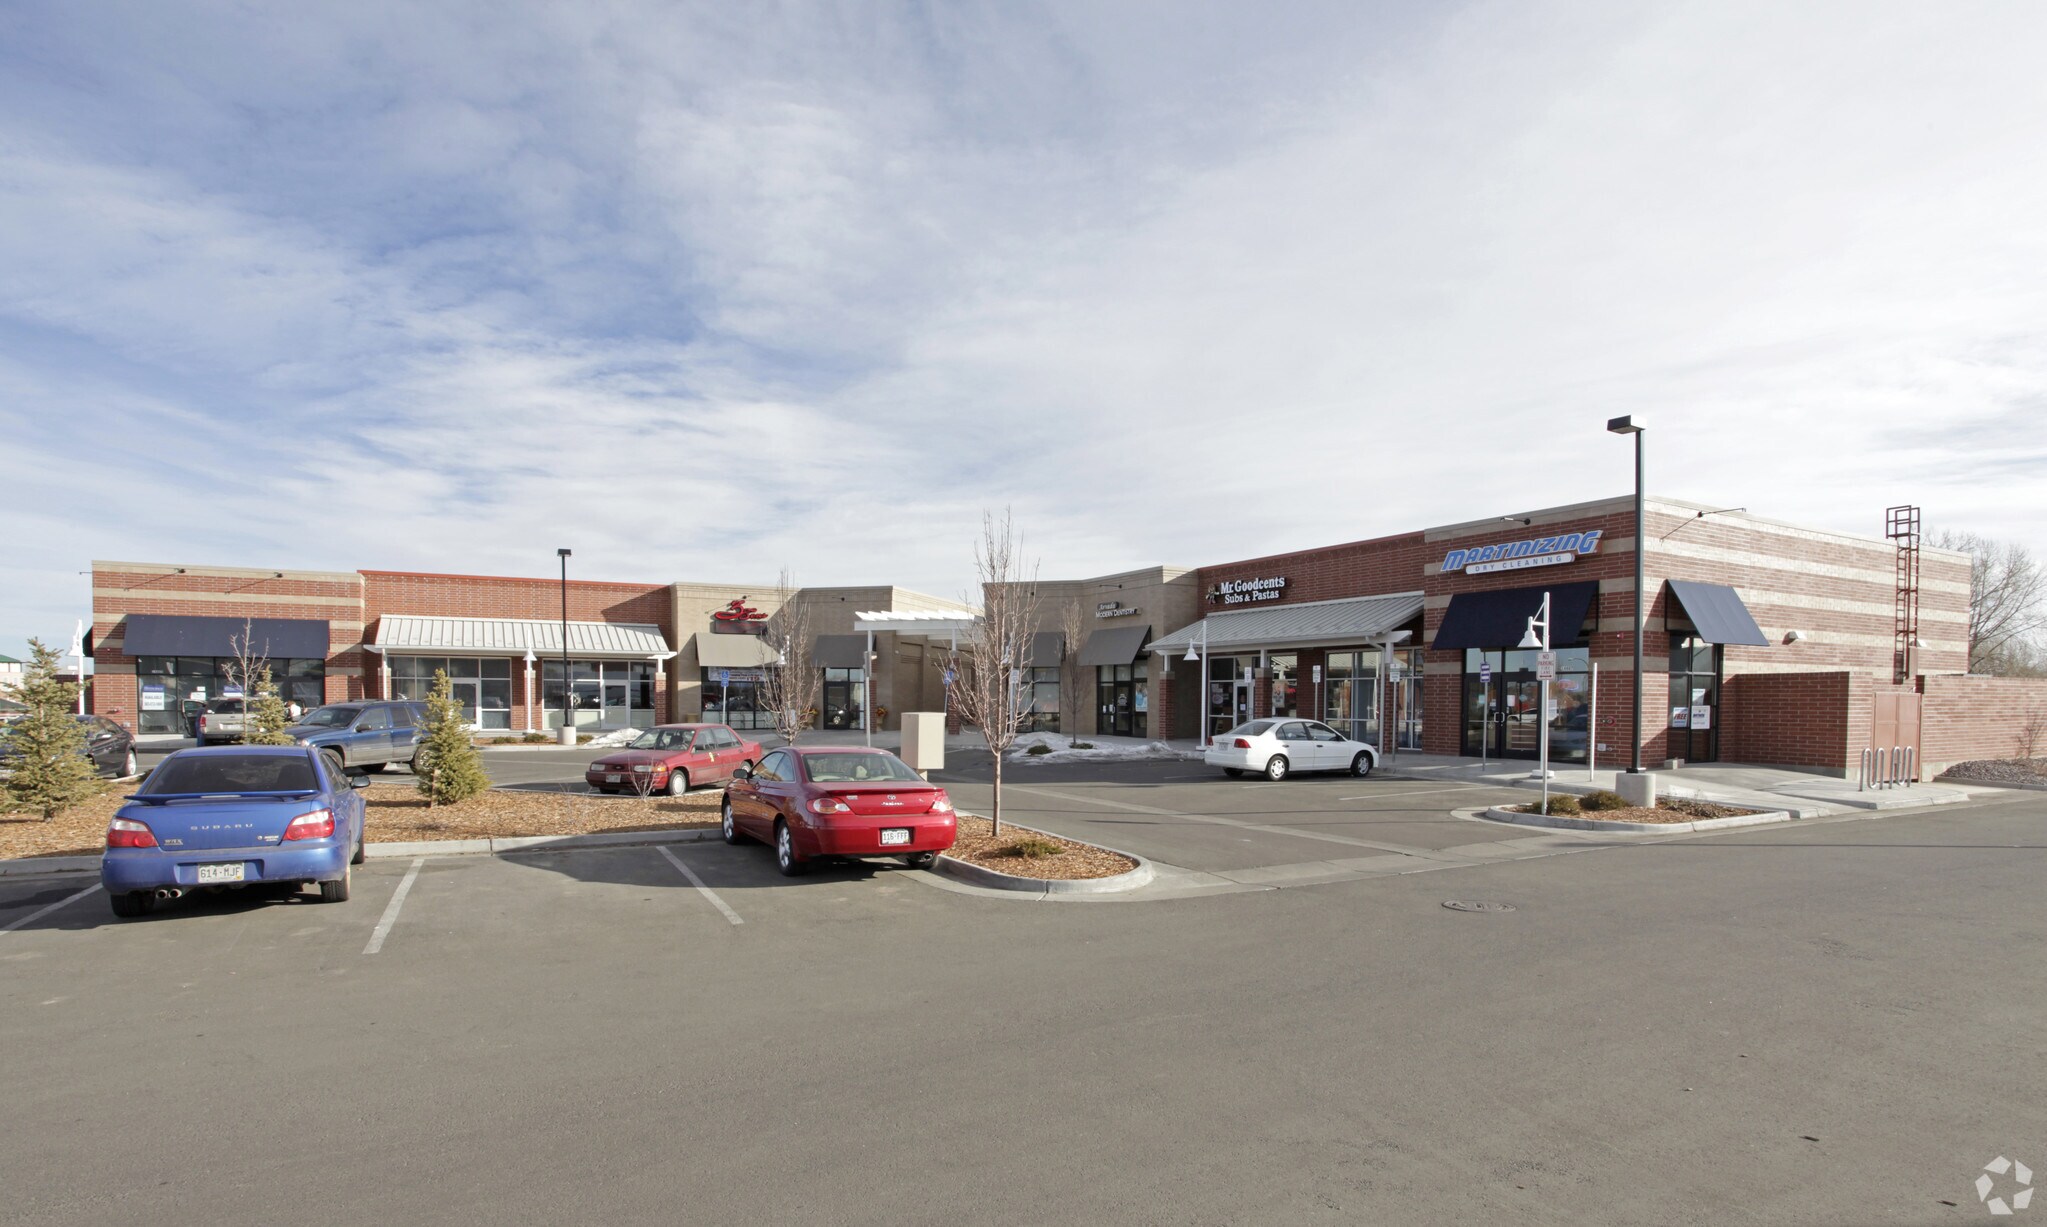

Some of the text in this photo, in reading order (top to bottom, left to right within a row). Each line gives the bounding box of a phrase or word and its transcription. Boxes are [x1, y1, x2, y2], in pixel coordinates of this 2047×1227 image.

[1441, 530, 1603, 571] MARTINIZING
[1474, 556, 1563, 573] DRY CLEANING
[1234, 576, 1286, 593] Goodcents
[1224, 590, 1280, 605] Subs & Pastas
[190, 823, 253, 831] SUBARU
